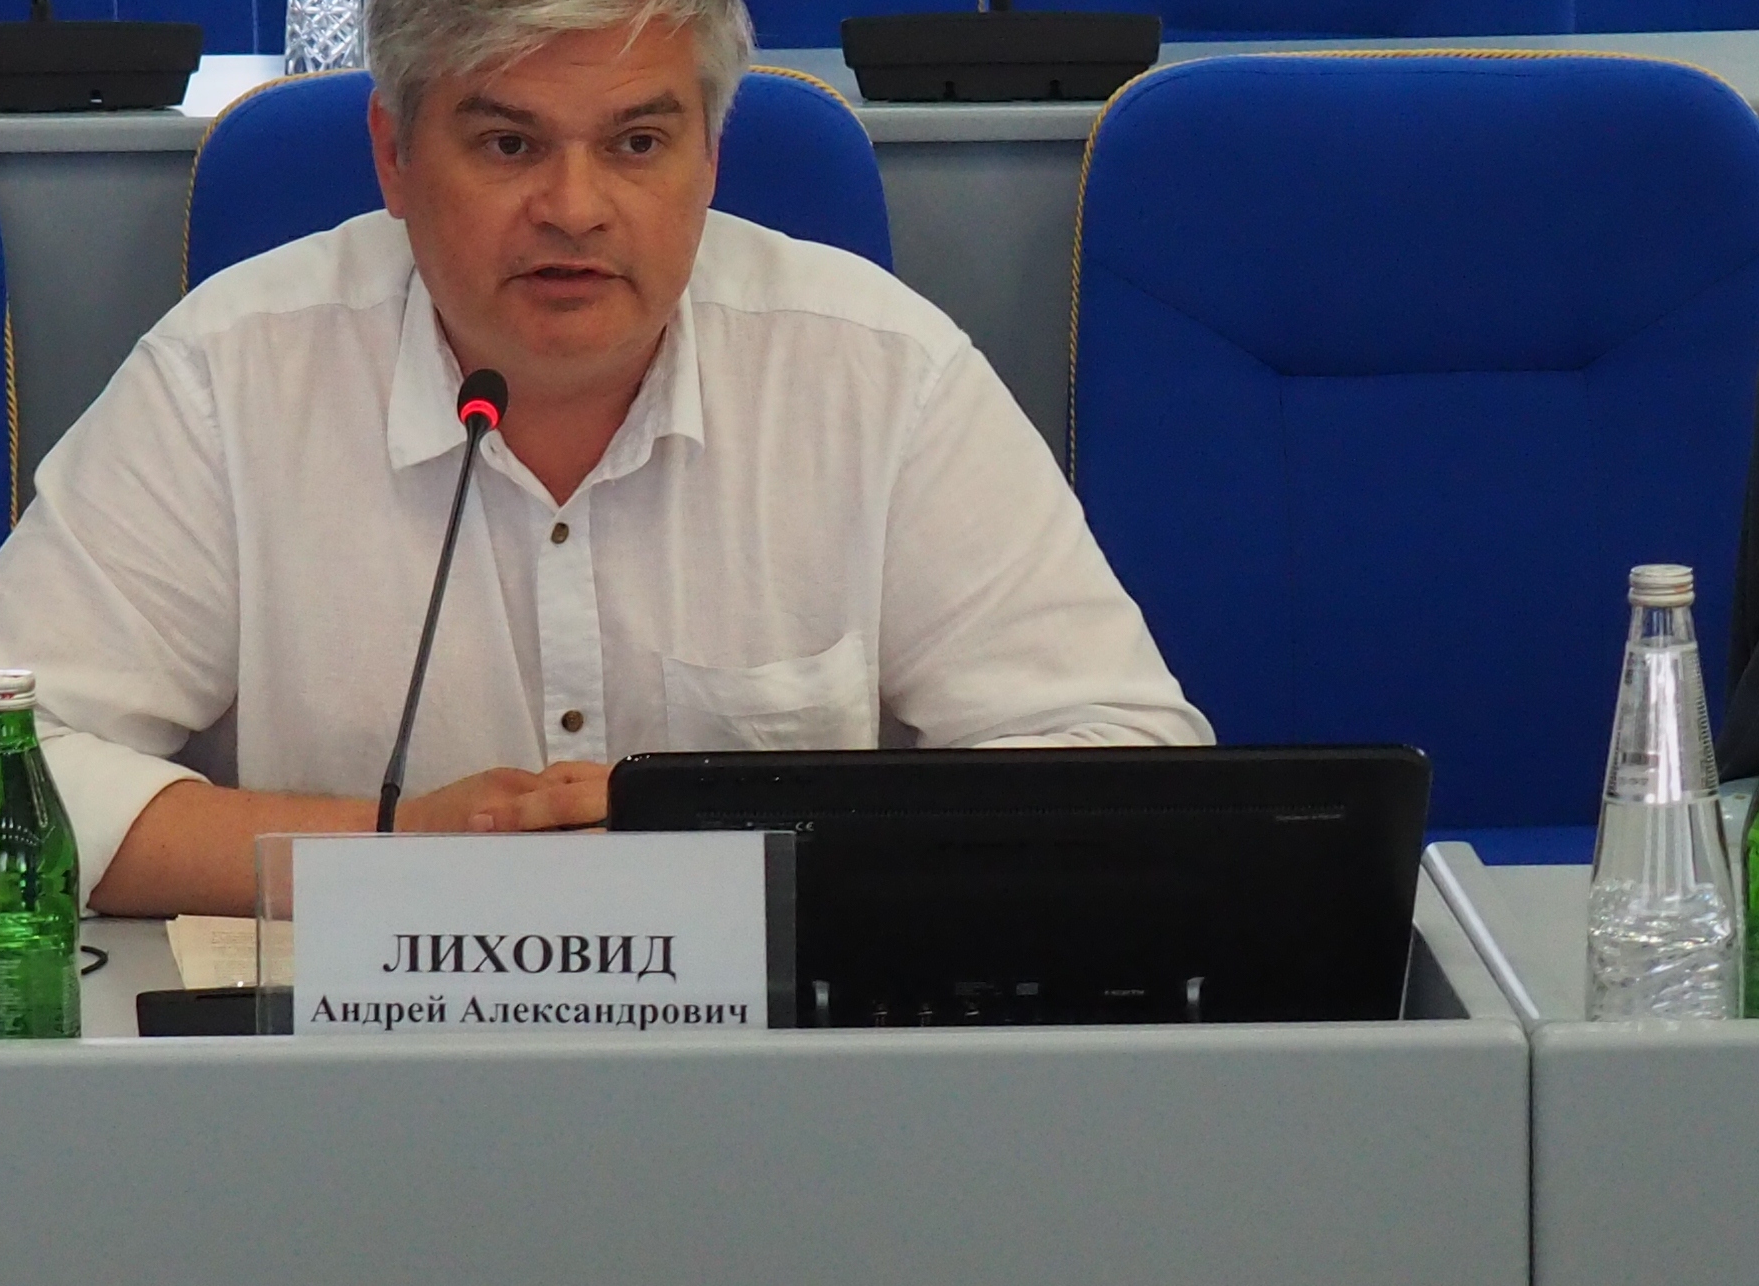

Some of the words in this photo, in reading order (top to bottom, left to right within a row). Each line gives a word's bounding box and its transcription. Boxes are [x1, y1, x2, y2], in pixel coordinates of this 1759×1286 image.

[382, 934, 677, 982] ЛИХОВИД
[310, 994, 446, 1031] Андрей
[459, 995, 749, 1031] Александрович
